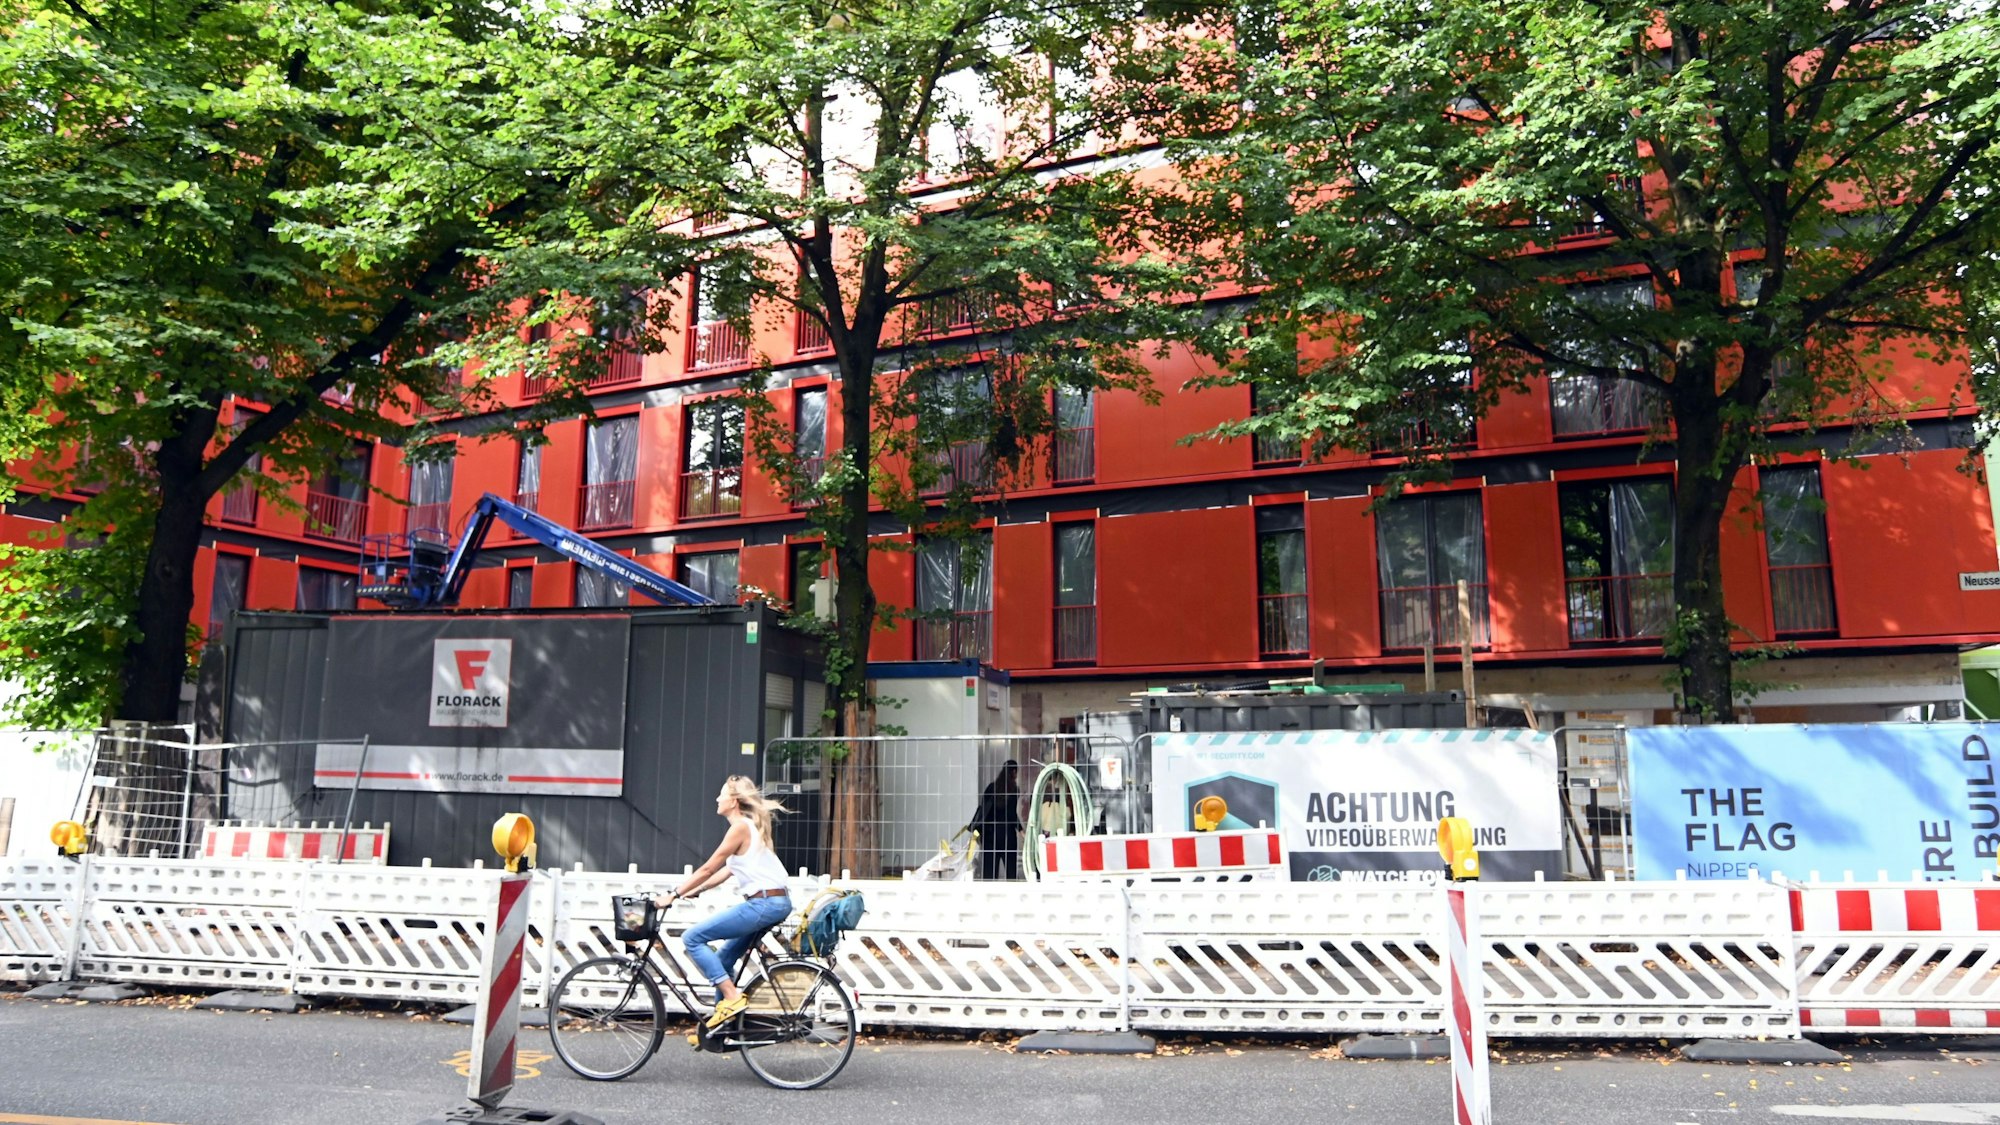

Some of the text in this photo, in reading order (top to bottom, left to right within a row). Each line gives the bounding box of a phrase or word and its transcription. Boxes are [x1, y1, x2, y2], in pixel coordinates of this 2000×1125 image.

[453, 650, 491, 690] F
[437, 695, 502, 707] FLORACK
[431, 772, 504, 782] www.florack.de
[1306, 790, 1455, 823] ACHTUNG
[1681, 787, 1764, 816] THE
[1961, 734, 2000, 858] BUILD
[1306, 825, 1507, 847] VIDEOÜBERWAUNG
[1685, 822, 1796, 852] FLAG
[1919, 820, 1956, 881] RE
